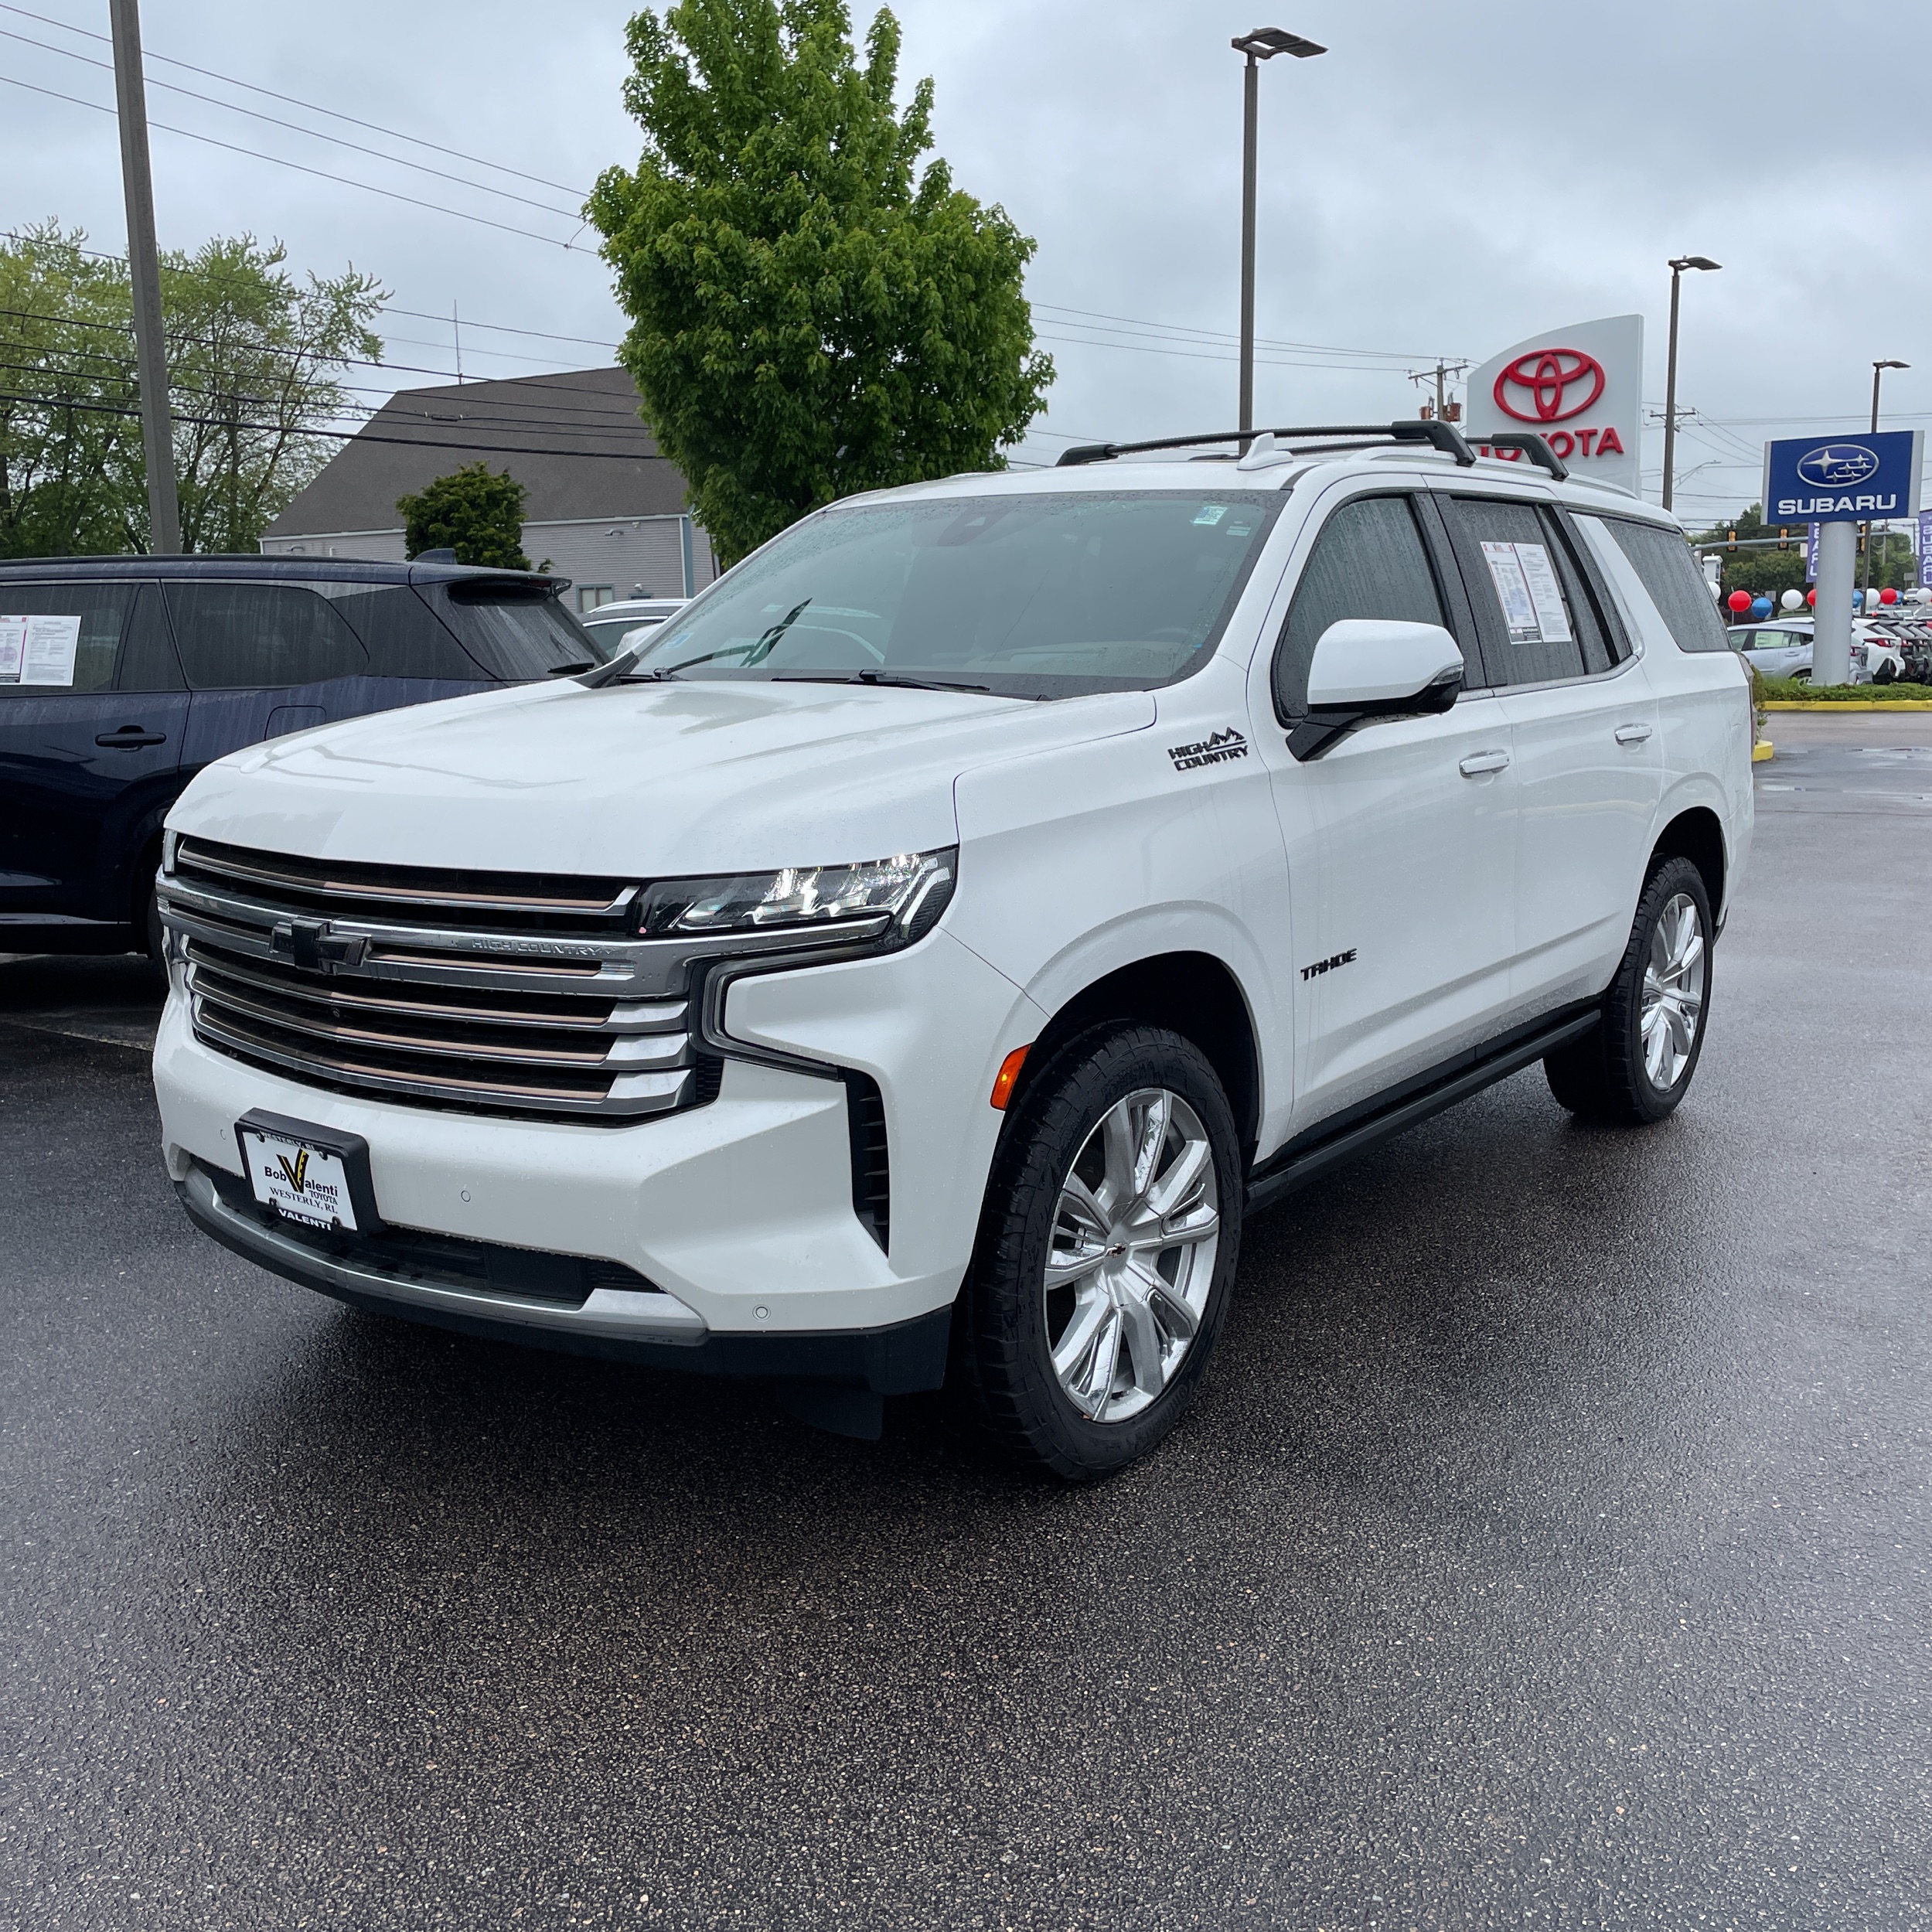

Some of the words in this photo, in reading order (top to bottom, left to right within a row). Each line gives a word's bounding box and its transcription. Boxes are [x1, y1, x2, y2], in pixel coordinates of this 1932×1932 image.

[1777, 493, 1897, 516] SUBARU
[1167, 741, 1210, 759] HIGH
[1174, 745, 1249, 771] COUNTRY
[472, 938, 512, 952] HIGH
[517, 942, 601, 956] COUNTRY
[1300, 948, 1358, 982] TAHOE
[264, 1166, 287, 1182] Bob
[269, 1186, 323, 1211] WESTERLY,
[309, 1190, 338, 1206] TOYOTA
[278, 1208, 332, 1231] VALENTI
